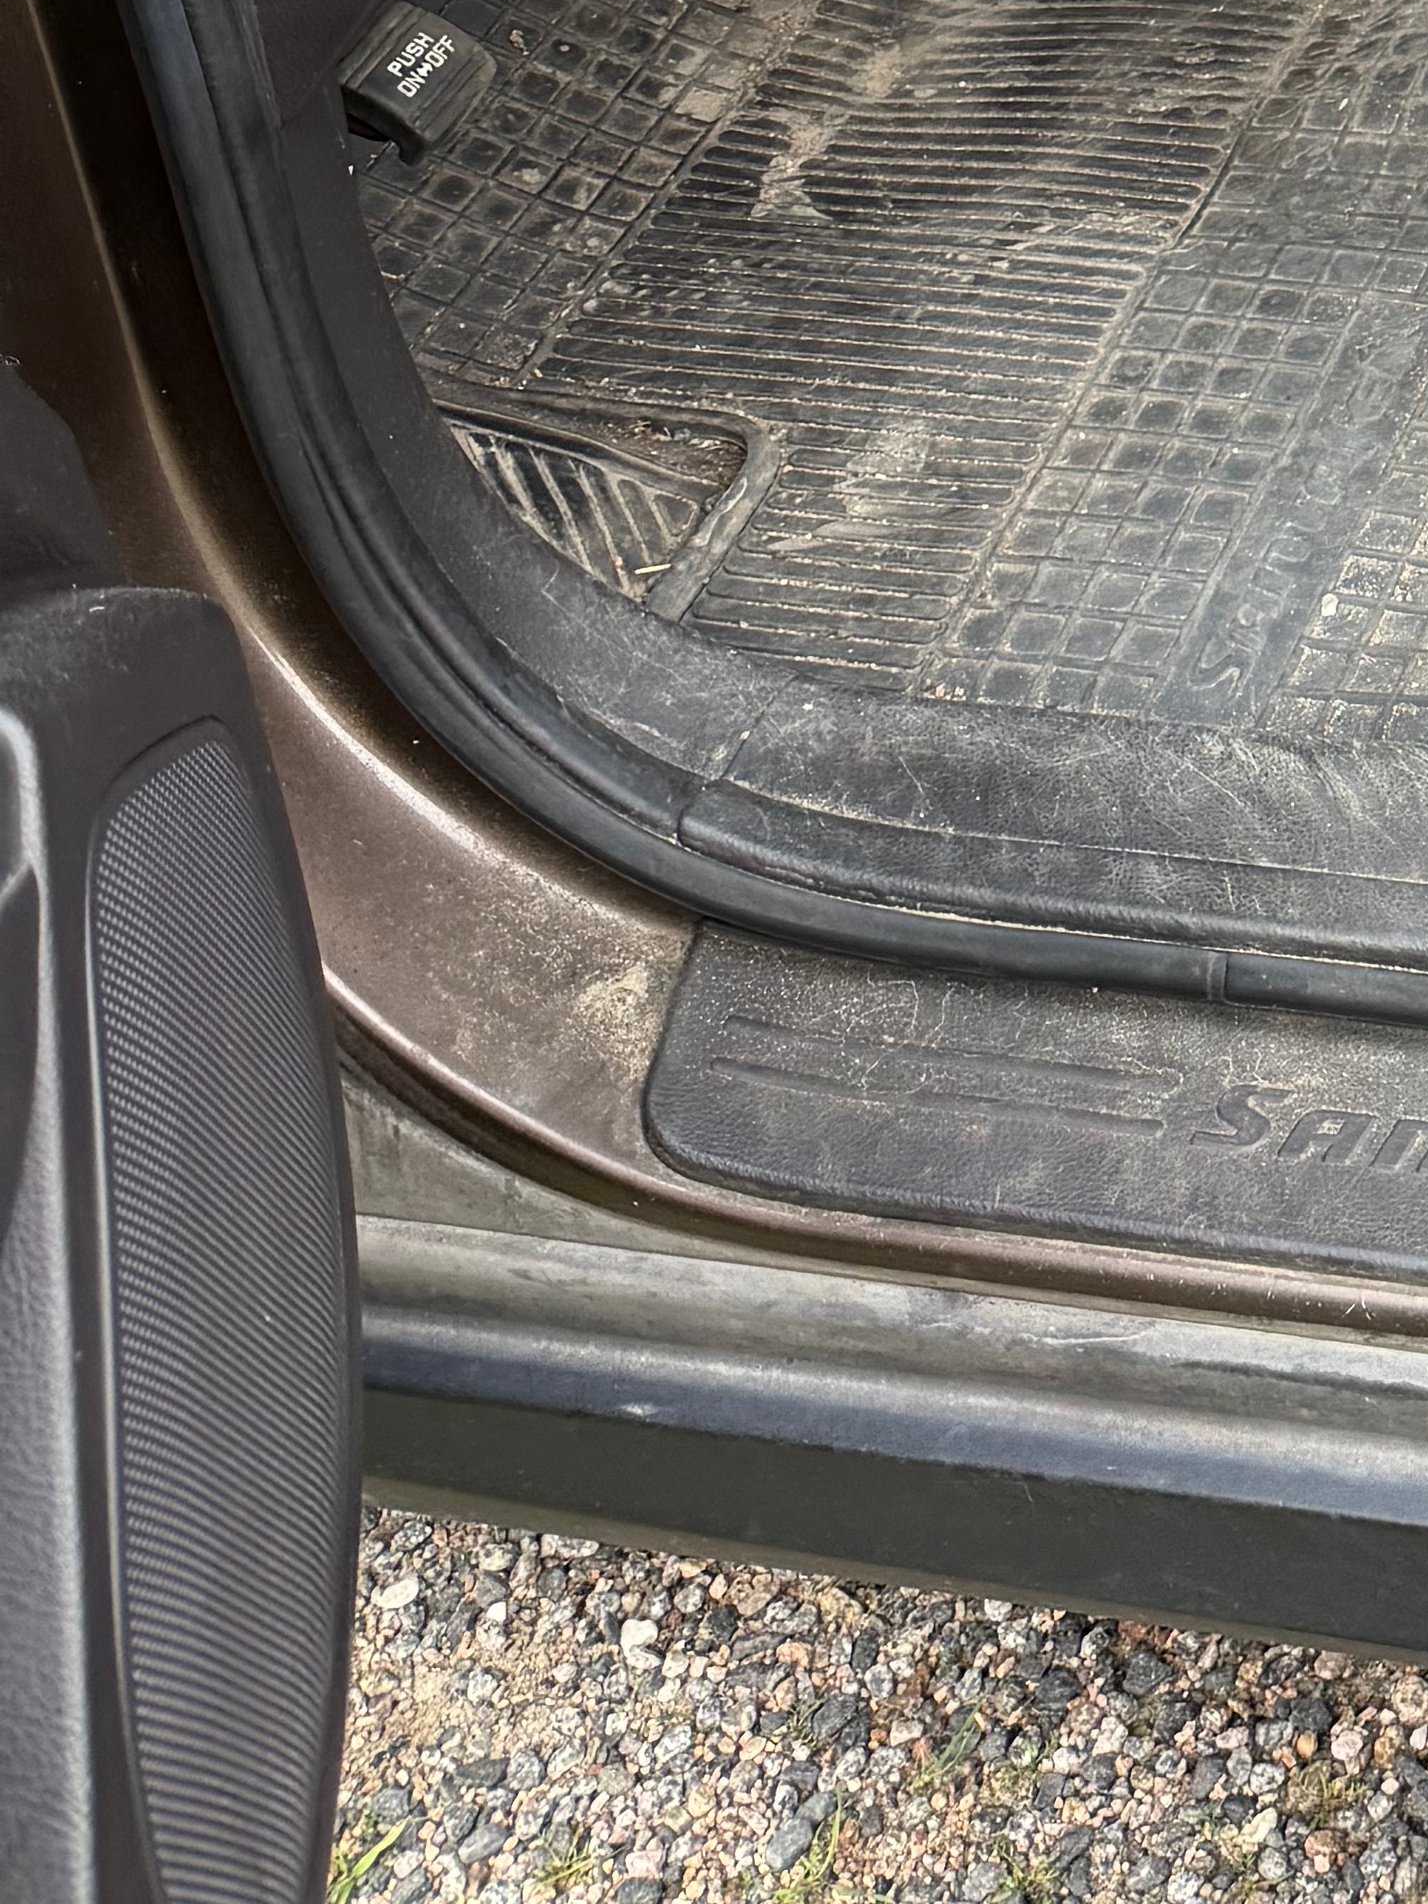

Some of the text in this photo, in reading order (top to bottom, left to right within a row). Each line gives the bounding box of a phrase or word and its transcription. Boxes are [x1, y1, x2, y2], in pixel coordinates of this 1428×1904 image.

[387, 32, 435, 78] PUSH
[397, 35, 456, 98] ON OFF
